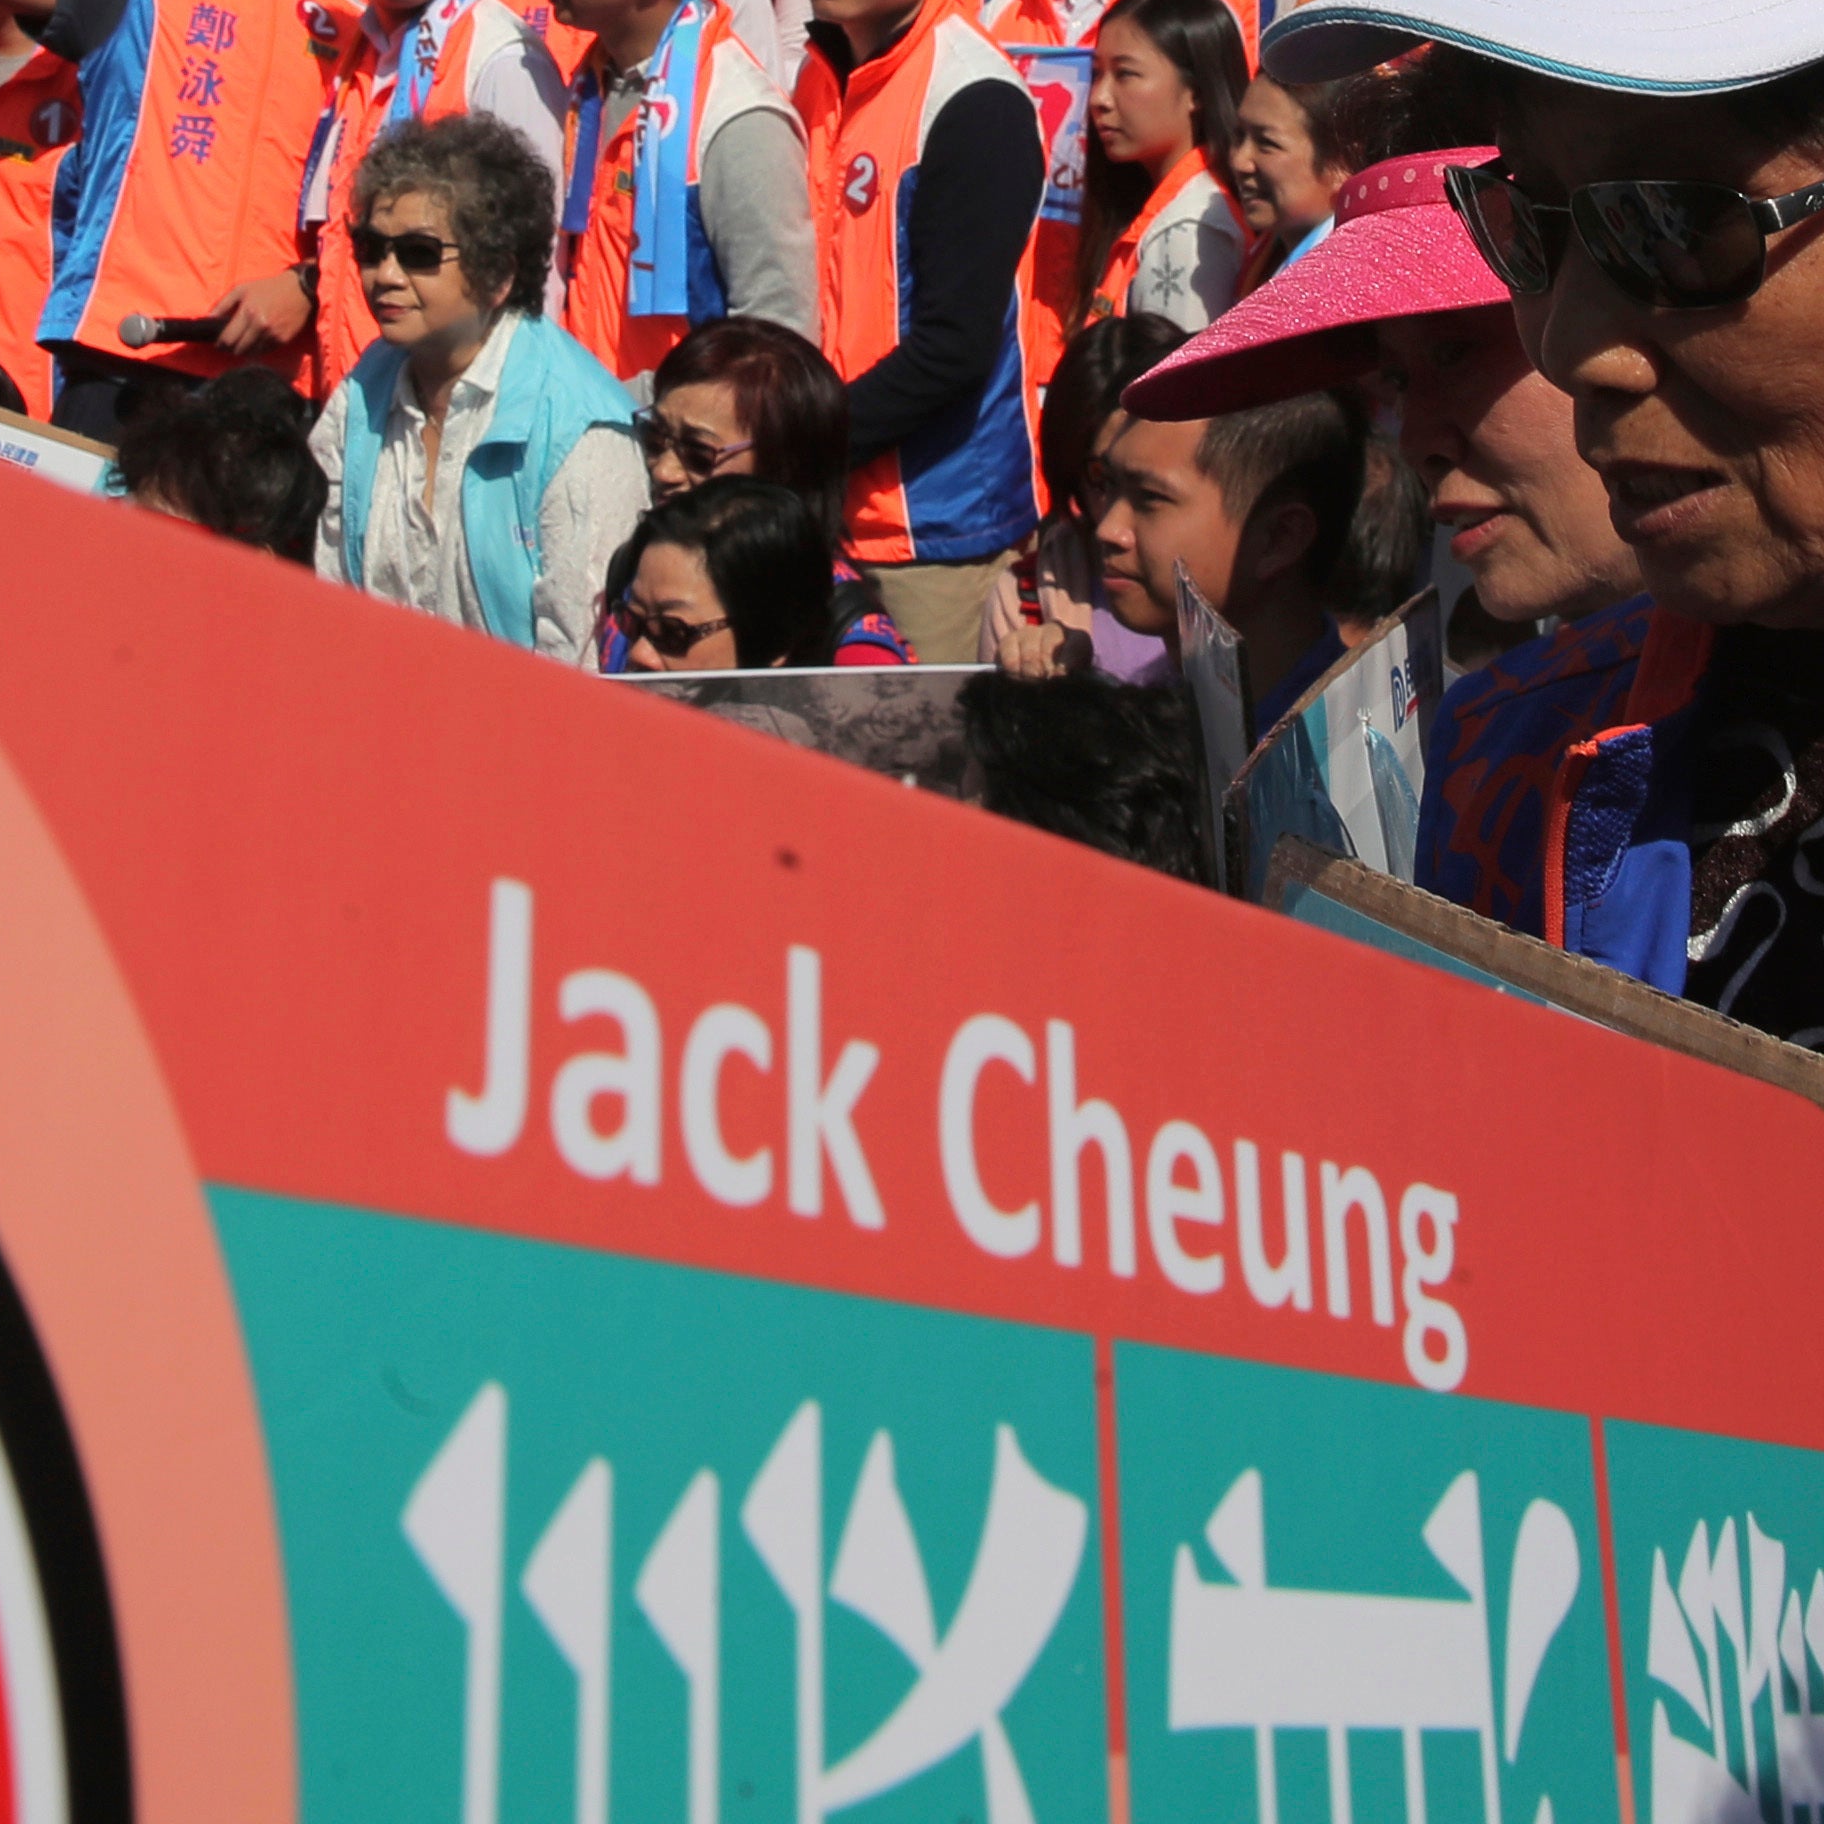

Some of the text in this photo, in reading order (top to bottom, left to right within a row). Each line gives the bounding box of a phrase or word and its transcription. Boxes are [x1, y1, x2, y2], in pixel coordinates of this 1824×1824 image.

[302, 0, 337, 35] 2
[170, 2, 238, 165] 鄭泳舜
[38, 101, 62, 144] 1
[847, 158, 876, 205] 2
[444, 876, 1470, 1395] Jack Cheung
